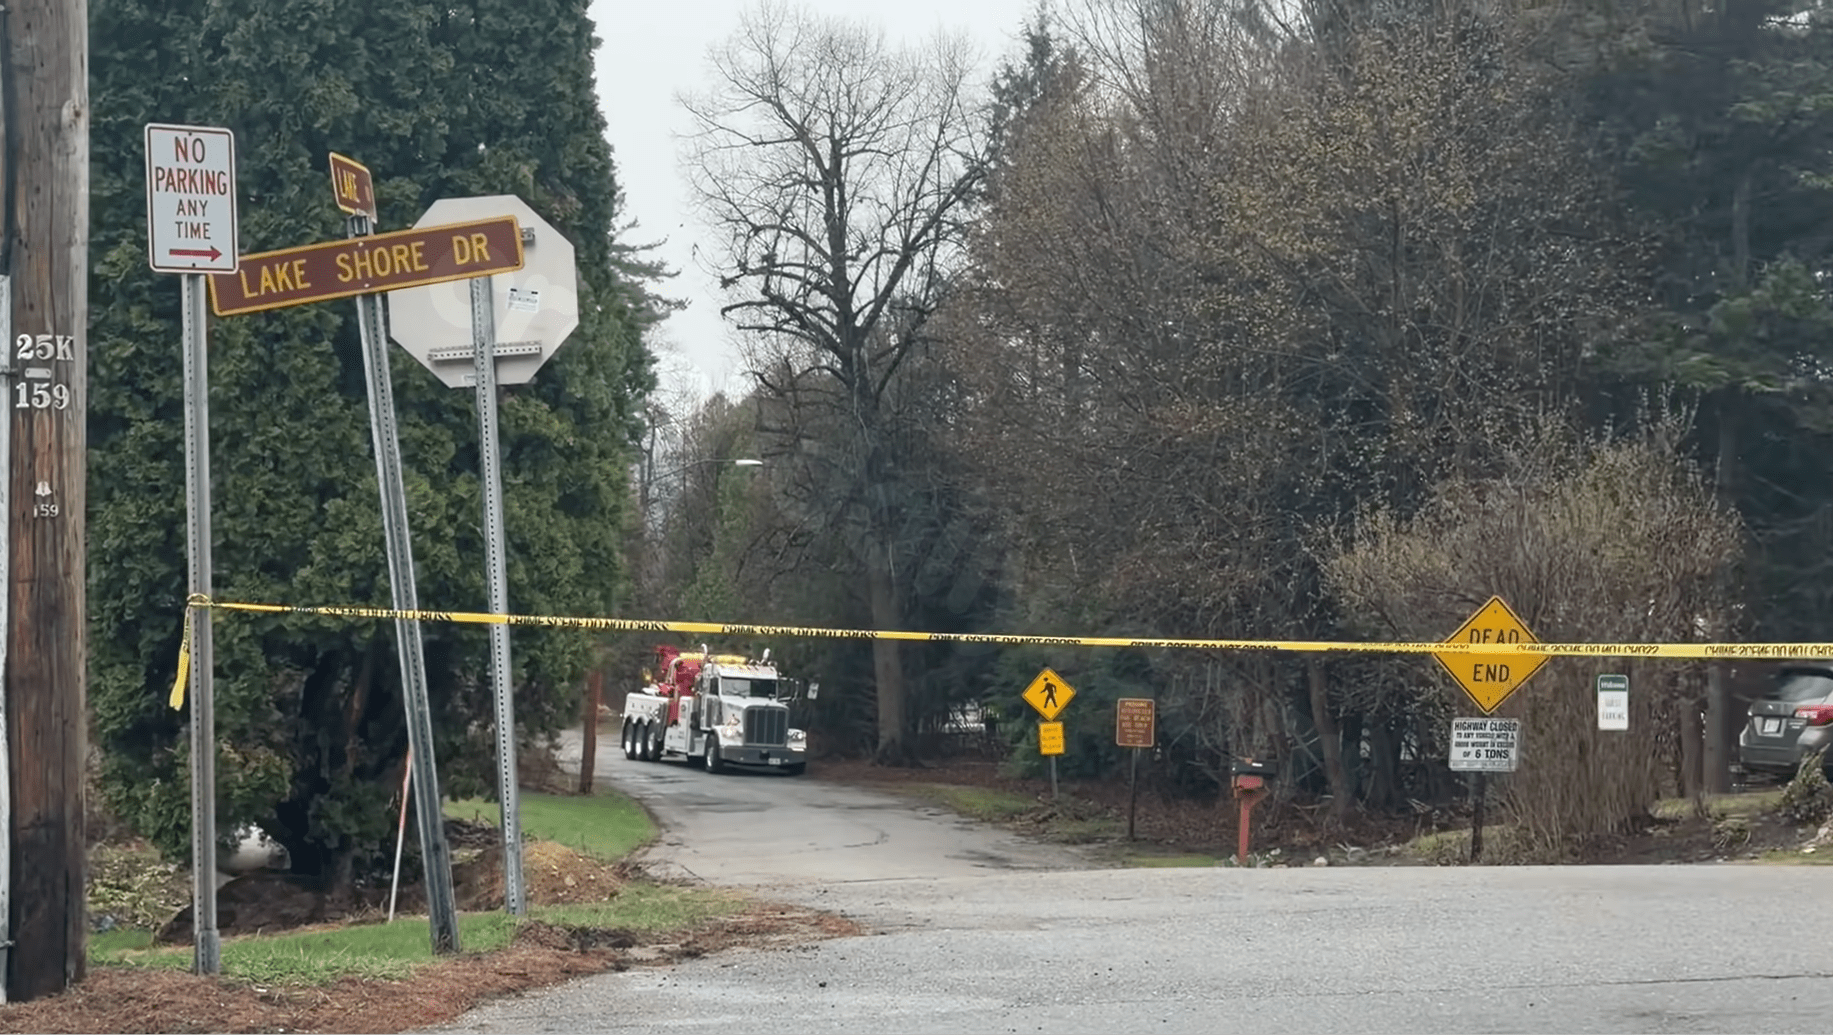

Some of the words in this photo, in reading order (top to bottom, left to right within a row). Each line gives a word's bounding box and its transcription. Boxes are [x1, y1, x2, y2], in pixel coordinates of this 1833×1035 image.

[175, 136, 205, 163] NO
[155, 166, 227, 195] PARKING
[176, 199, 208, 217] ANY
[175, 221, 211, 240] TIME
[239, 258, 311, 299] LAKE
[336, 241, 429, 283] SHORE
[451, 232, 491, 265] DR
[16, 333, 75, 361] 25K
[15, 382, 70, 410] 159
[1469, 628, 1520, 644] DEAD
[1473, 663, 1510, 682] END
[1454, 721, 1488, 731] HIGHWAY
[1489, 721, 1518, 731] CLOSED
[1475, 749, 1481, 759] 6
[1485, 749, 1509, 759] TONS
